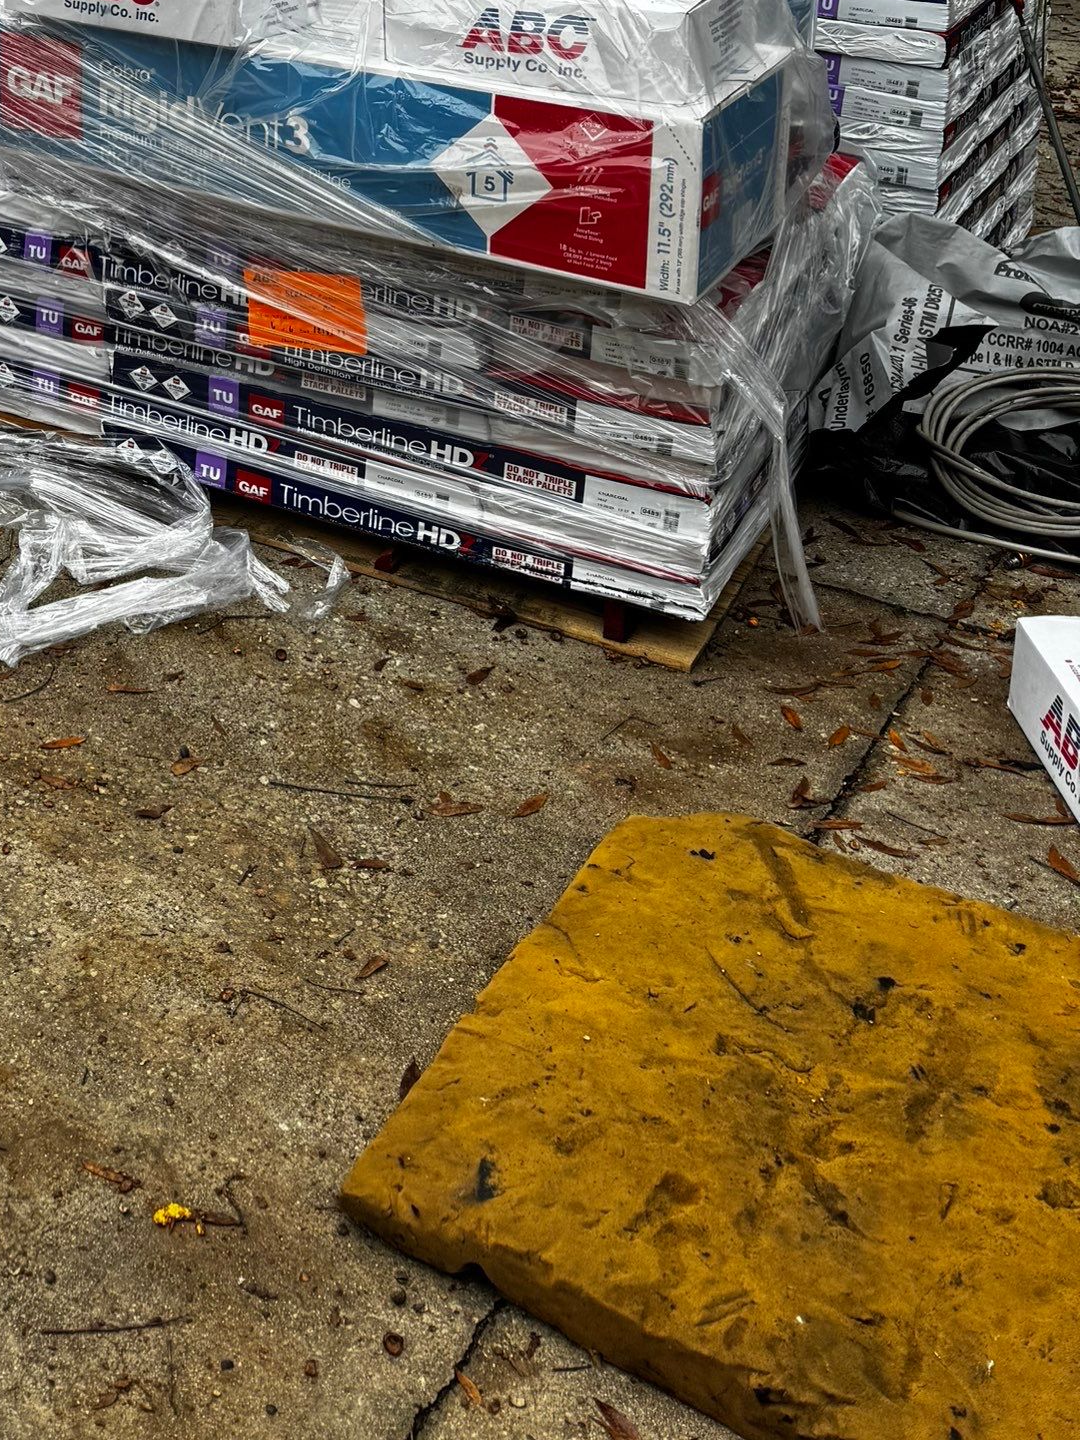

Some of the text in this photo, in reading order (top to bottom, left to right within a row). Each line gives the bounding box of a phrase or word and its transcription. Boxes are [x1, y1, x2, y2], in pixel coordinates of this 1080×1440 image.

[111, 4, 132, 19] Co.
[135, 8, 160, 23] inc.
[456, 7, 597, 60] ABC
[99, 60, 150, 81] Cobra
[463, 52, 588, 80] Supply Co. inc.
[7, 65, 73, 105] GAF
[483, 175, 495, 192] 5
[29, 244, 46, 259] TU
[657, 221, 671, 291] Width: 11.5"
[62, 257, 88, 271] GAF
[921, 284, 943, 311] D8257
[41, 308, 59, 324] TU
[201, 317, 220, 332] TU
[893, 297, 918, 344] Series-06
[75, 322, 102, 336] GAF
[512, 316, 583, 340] DO NOT TRIPLE
[917, 312, 939, 343] ASTM
[988, 333, 1033, 351] CCRR#
[1036, 339, 1064, 354] 1004
[994, 352, 1001, 366] &
[1015, 356, 1024, 369] &
[304, 379, 329, 392] STACK
[330, 385, 364, 400] PALLETS
[859, 352, 876, 406] 16850
[213, 388, 234, 405] TU
[831, 359, 851, 430] Underlaym
[252, 403, 283, 419] GAF
[534, 400, 565, 415] TRIPLE
[200, 464, 221, 482] TU
[297, 452, 357, 475] DO NOT TRIPLE
[506, 472, 574, 497] STACK PALLETS
[507, 463, 575, 490] DO NOT TRIPLE
[239, 480, 269, 497] GAF
[495, 547, 562, 571] DO NOT TRIPLE
[1040, 694, 1080, 772] AB
[1040, 729, 1078, 799] Supply Co.
